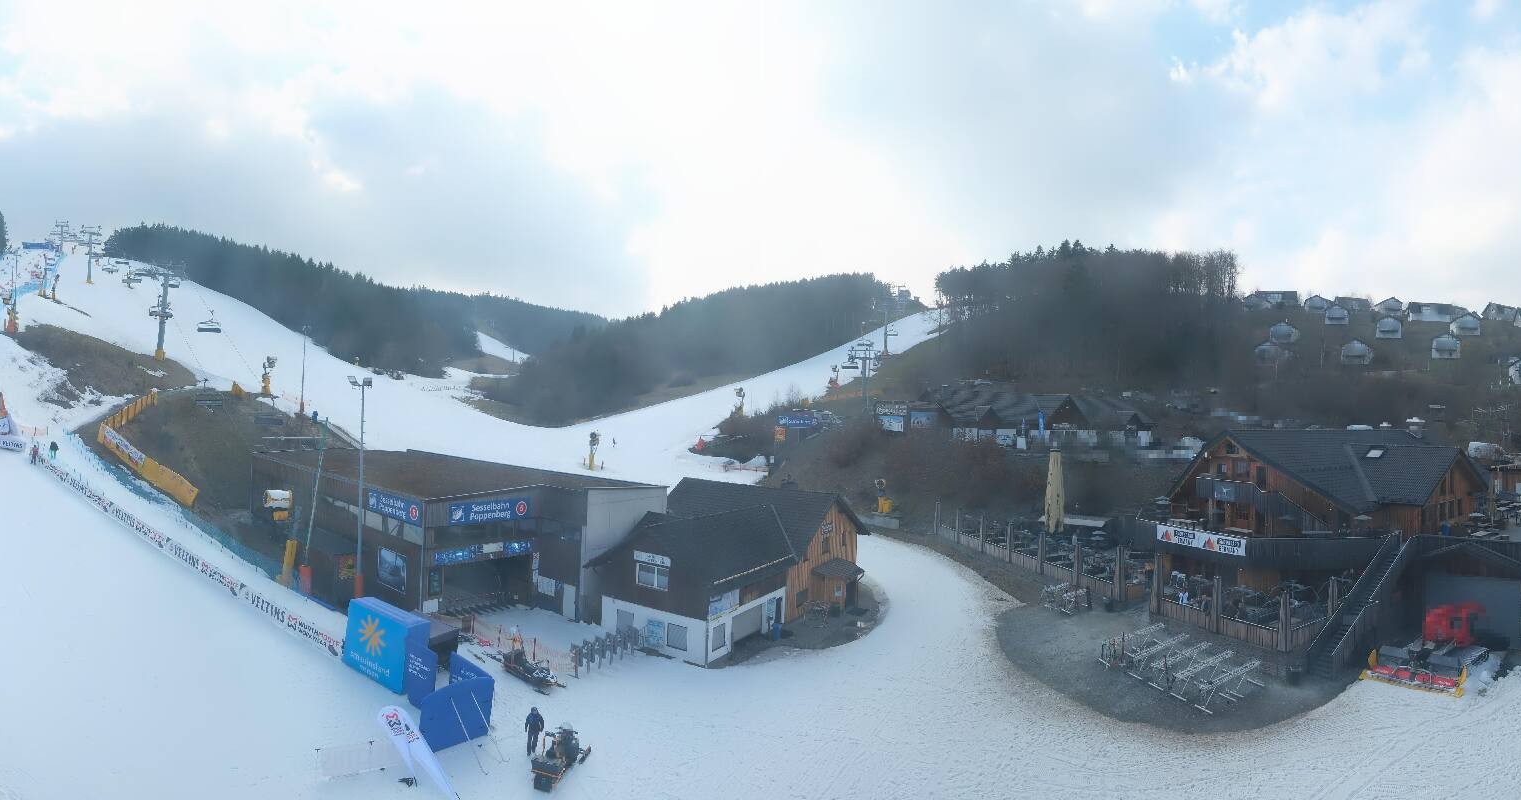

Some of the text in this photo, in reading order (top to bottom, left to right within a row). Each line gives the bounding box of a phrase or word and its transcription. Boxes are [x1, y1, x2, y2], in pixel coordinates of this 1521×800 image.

[469, 509, 511, 522] Poppenberg
[471, 501, 510, 512] Sesselbahn
[174, 544, 200, 570] VELTINS
[251, 592, 286, 624] VELTINS
